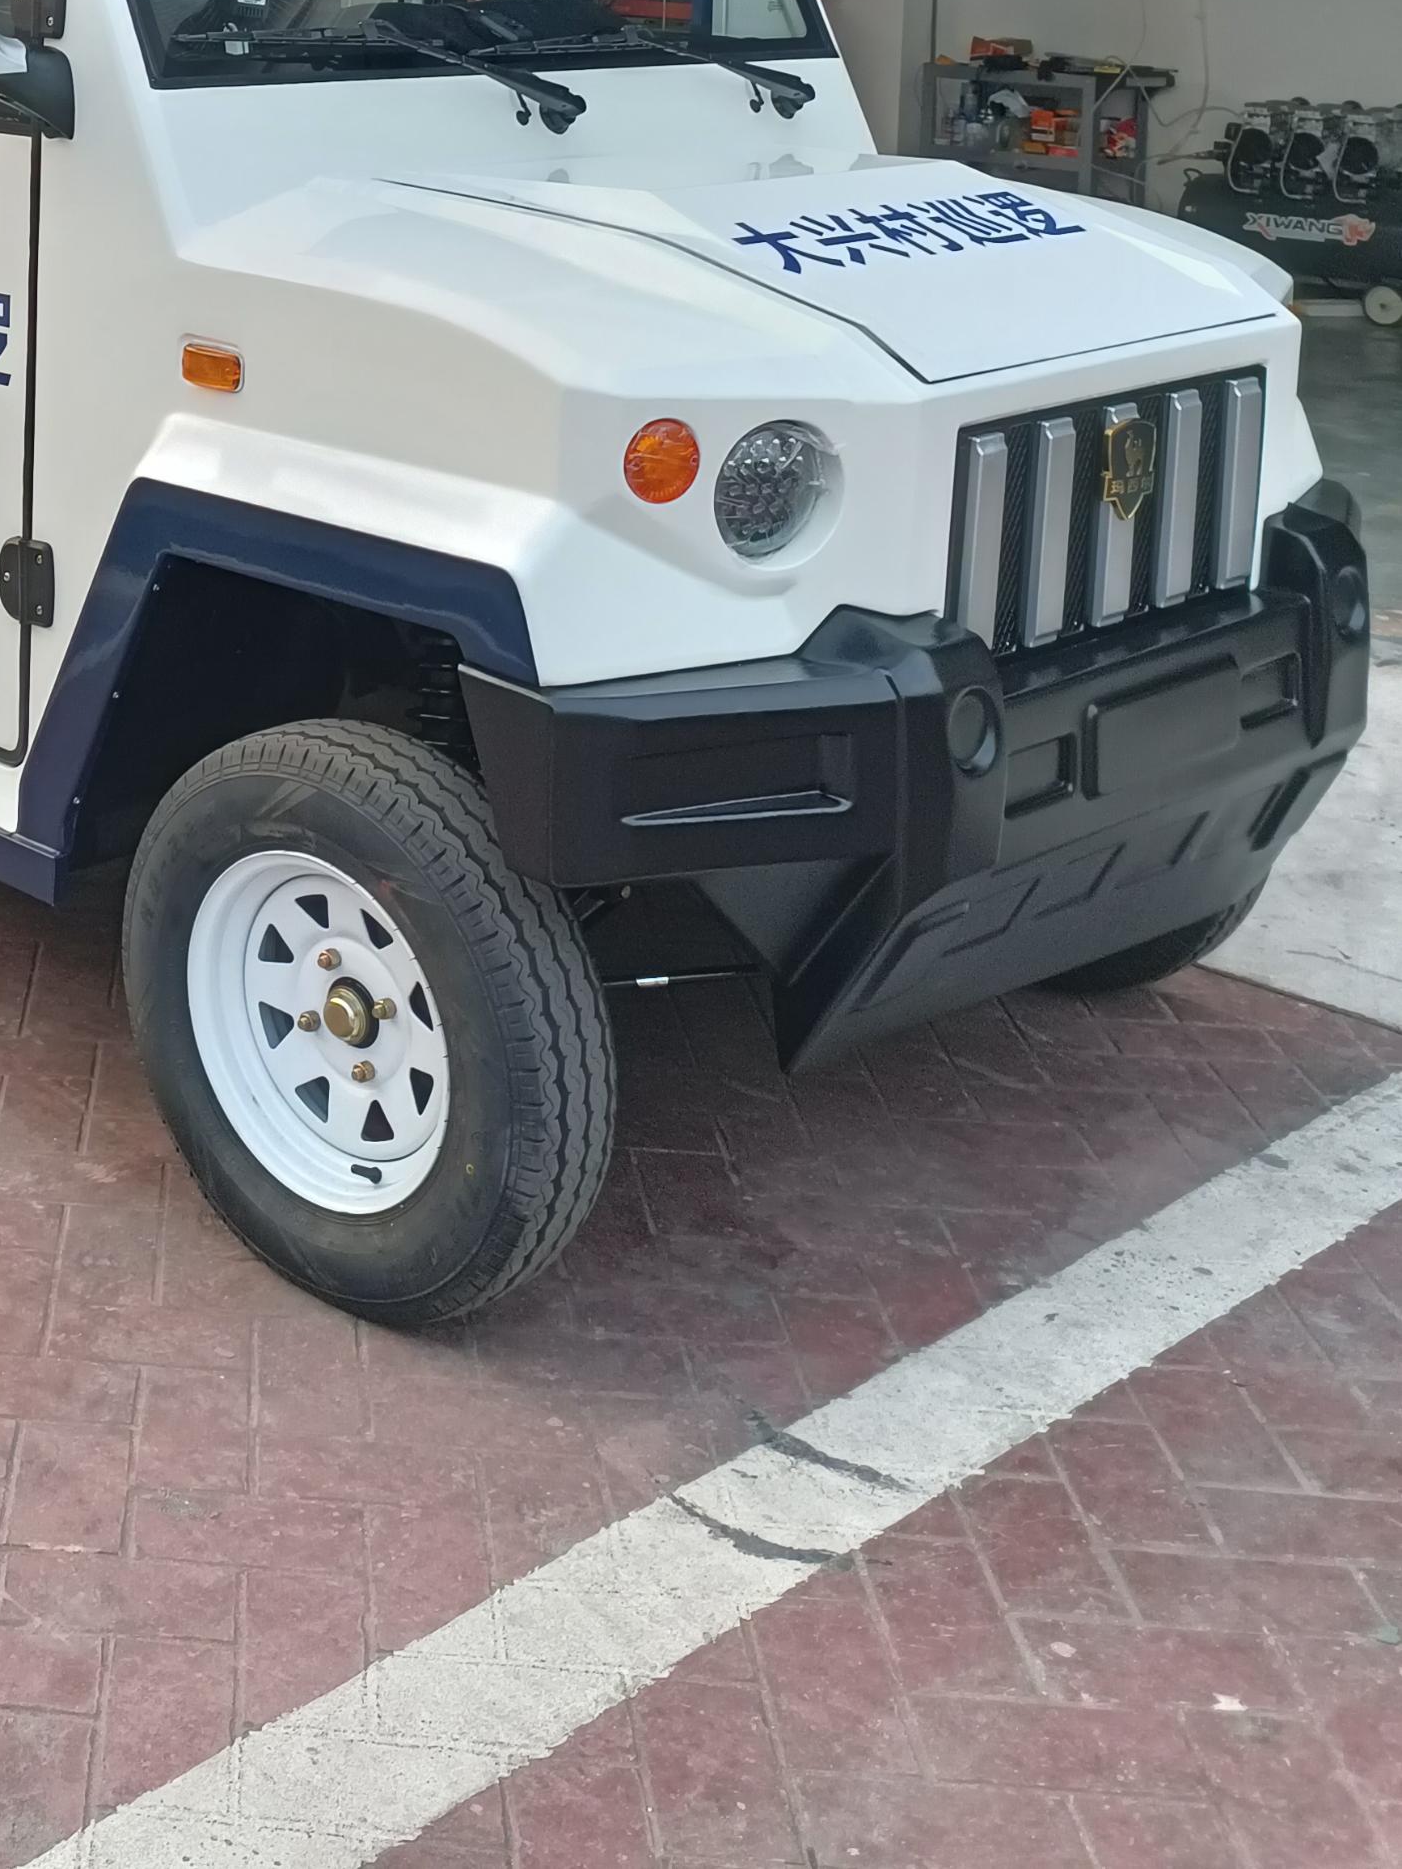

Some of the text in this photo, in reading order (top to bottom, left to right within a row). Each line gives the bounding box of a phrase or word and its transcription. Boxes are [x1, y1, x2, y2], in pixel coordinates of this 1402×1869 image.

[731, 191, 1087, 275] 大兴村巡逻
